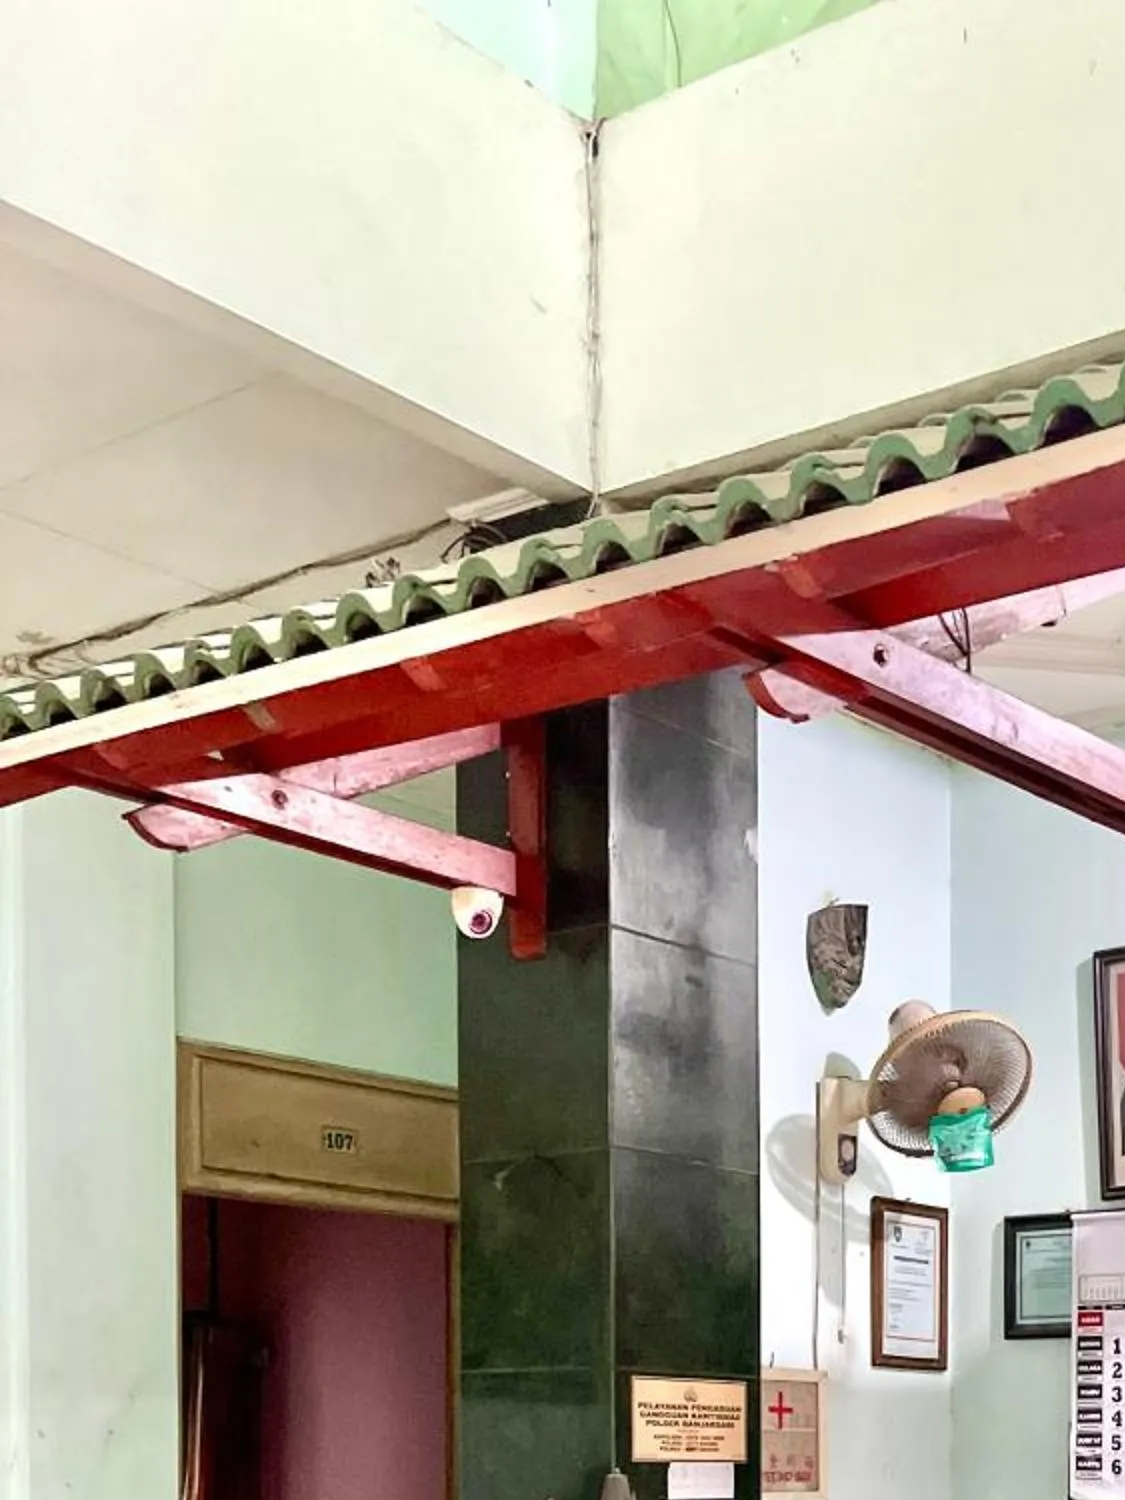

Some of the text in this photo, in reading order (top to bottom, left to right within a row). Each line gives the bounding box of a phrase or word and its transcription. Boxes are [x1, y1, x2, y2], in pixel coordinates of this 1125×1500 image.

[327, 1132, 353, 1150] 107
[1113, 1337, 1121, 1355] 1
[1111, 1361, 1123, 1379] 2
[1111, 1386, 1123, 1403] 3
[1111, 1410, 1123, 1428] 4
[1111, 1434, 1122, 1451] 5
[1111, 1459, 1122, 1476] 6
